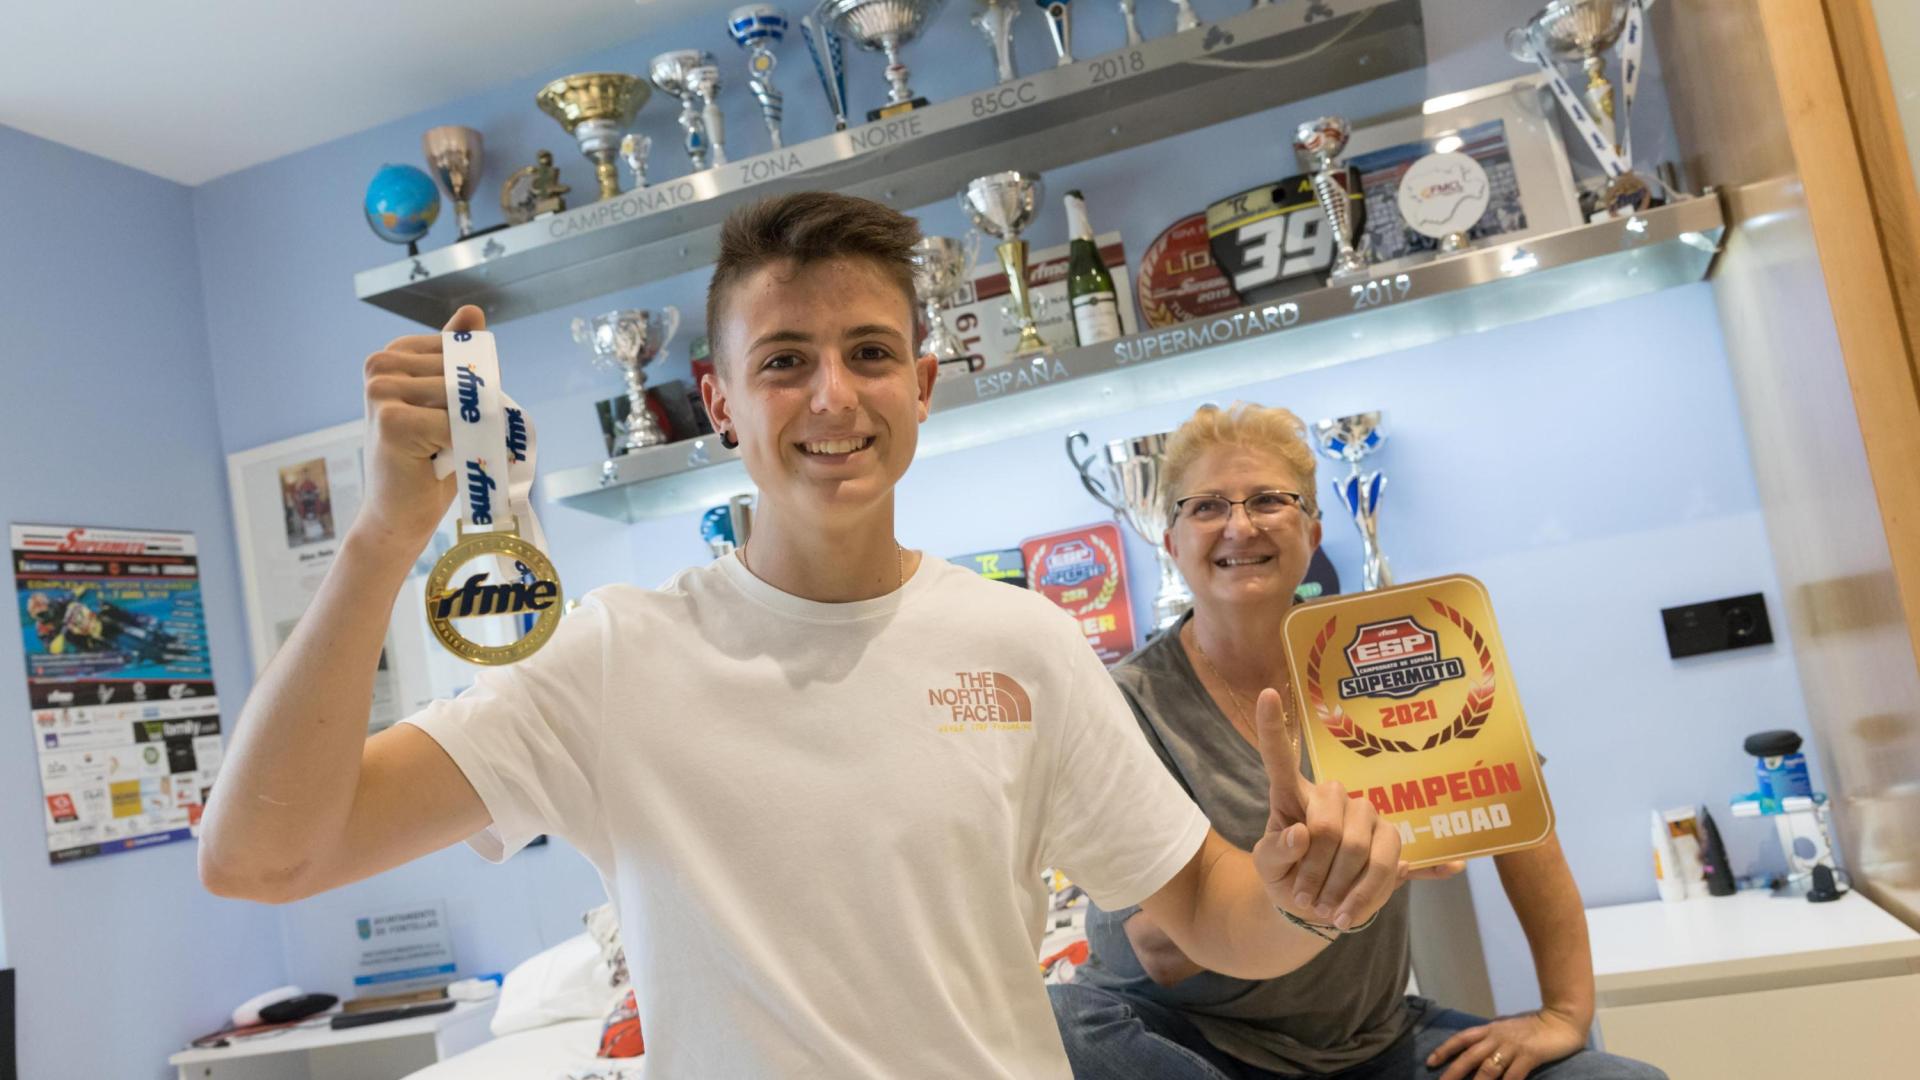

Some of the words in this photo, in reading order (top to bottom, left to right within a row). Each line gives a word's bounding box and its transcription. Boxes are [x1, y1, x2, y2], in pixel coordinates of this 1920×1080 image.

[548, 182, 696, 239] CAMPEONATO
[741, 152, 804, 184] ZONA
[850, 117, 923, 154] NORTE
[971, 82, 1037, 118] 85CC
[1088, 51, 1146, 84] 2018
[1234, 207, 1337, 293] 39
[974, 357, 1070, 397] ESPAÑA
[1114, 302, 1299, 364] SUPERMOTARD
[1350, 274, 1412, 311] 2019
[456, 364, 485, 423] rfme
[467, 460, 496, 526] rfme
[436, 572, 557, 619] rfme
[1356, 634, 1427, 661] ESP
[928, 688, 996, 706] NORTH
[955, 671, 993, 688] THE
[1344, 660, 1460, 697] SUPERMOTO
[952, 705, 998, 722] FACE
[1379, 699, 1438, 729] 2021
[1346, 760, 1522, 816] AMPEÓN
